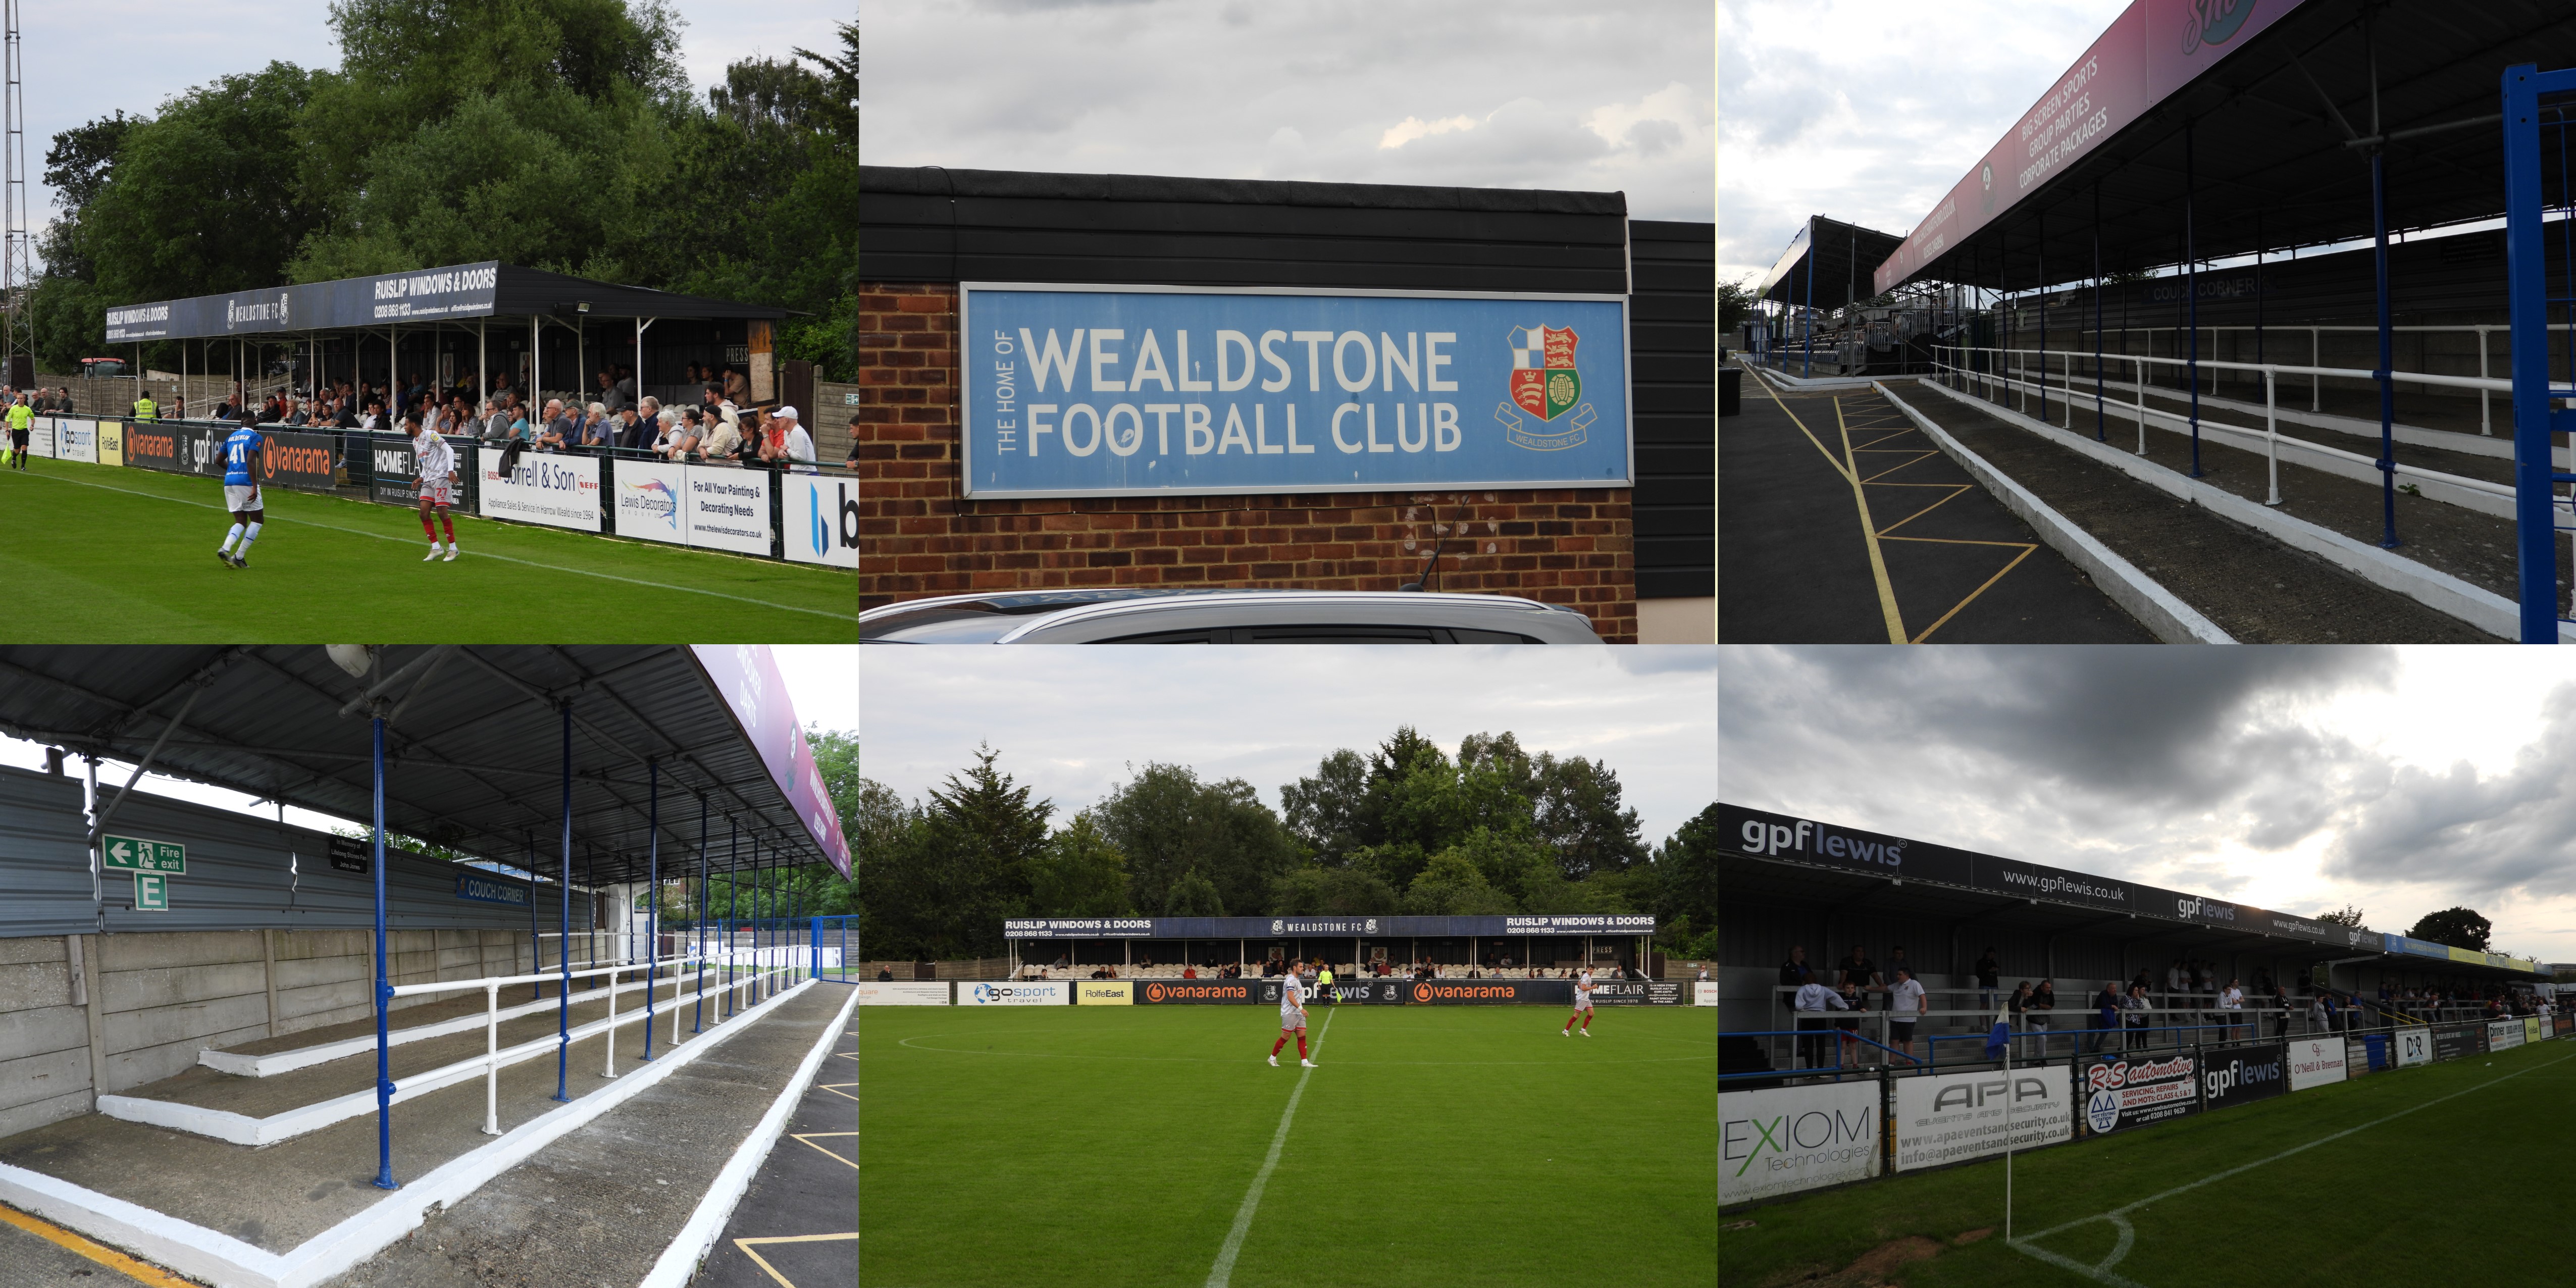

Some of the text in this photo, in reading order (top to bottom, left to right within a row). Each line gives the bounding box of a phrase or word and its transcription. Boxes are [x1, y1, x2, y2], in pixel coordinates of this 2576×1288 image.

[2022, 55, 2097, 141] BIG SCREEN SPORTS
[2029, 91, 2089, 158] GROUP PARTIES
[2020, 107, 2106, 188] CORPORATE PACKAGES
[375, 268, 496, 299] RUISLIP WINDOWS & DOORS
[107, 310, 123, 325] RUISLIP
[124, 308, 146, 324] WINDOWS
[151, 306, 168, 321] DOORS
[236, 302, 278, 322] WEALDSTONE FC
[375, 303, 410, 318] 0208 868 1133
[727, 347, 748, 362] PRESS
[1019, 328, 1458, 392] WEALDSTONE
[995, 330, 1015, 455] THE HOME OF
[1028, 402, 1462, 456] FOOTBALL CLUB
[135, 434, 173, 458] vanarama
[1516, 434, 1579, 447] WEALDSTONE FC
[229, 443, 245, 463] 41
[276, 445, 329, 475] vanarama
[542, 462, 598, 491] & Son NEFF
[392, 488, 405, 497] RUISLIP
[406, 490, 417, 499] SINCE
[436, 488, 447, 496] 27
[694, 481, 703, 492] For
[712, 484, 727, 494] Your
[729, 485, 753, 498] Painting
[755, 487, 760, 497] &
[488, 498, 593, 520] Appliance Sales & Service in Harrow Weald since 1964
[622, 493, 676, 512] Lewis Decorators
[701, 501, 753, 517] Decorating Needs
[694, 524, 761, 538] www.thelewisdecorators.co.uk
[740, 679, 756, 728] DARTS
[161, 846, 179, 858] Fire
[341, 840, 356, 849] Memory
[1742, 820, 1901, 866] gpflewis
[331, 849, 346, 858] Lifelong
[161, 859, 179, 869] exit
[142, 877, 161, 905] E
[469, 880, 523, 902] COUCH CORNER
[2003, 871, 2124, 901] www.gpflewis.co.uk
[2178, 896, 2234, 920] gpflewis
[1005, 921, 1046, 929] RUISLIP
[1049, 920, 1101, 929] WINDOWS
[1114, 920, 1151, 928] DOORS
[1352, 923, 1361, 931] FC
[1617, 917, 1655, 925] DOORS
[2273, 919, 2325, 935] www.gpflewis.co.uk
[2349, 929, 2378, 945] gpflewis
[1167, 987, 1246, 998] vanarama
[1434, 987, 1514, 998] vanarama
[2090, 1058, 2192, 1090] R&S automotive
[2295, 1060, 2343, 1074] O'Neill & Brennan
[2183, 1074, 2194, 1085] Ltd
[2207, 1059, 2279, 1099] gpflewis
[1934, 1077, 2047, 1112] APA
[2122, 1084, 2178, 1098] SERVICING, REPAIRS
[2123, 1098, 2137, 1107] AND
[2138, 1096, 2156, 1104] MOTS:
[2157, 1092, 2174, 1101] CLASS
[1917, 1101, 2059, 1126] EVENTS AND SECURITY
[2139, 1099, 2196, 1114] www.randsautomotive.co.uk
[2150, 1111, 2163, 1119] 0208
[2174, 1107, 2185, 1115] 9620
[1901, 1112, 2070, 1148] www.apaeventsandsecurity.co.uk
[1725, 1106, 1869, 1177] EXIOM
[1901, 1125, 2070, 1165] info@apaeventsandsecurity.co.uk
[1765, 1146, 1869, 1171] Technologies
[1724, 1166, 1868, 1198] www.exiomtechnologies.com
